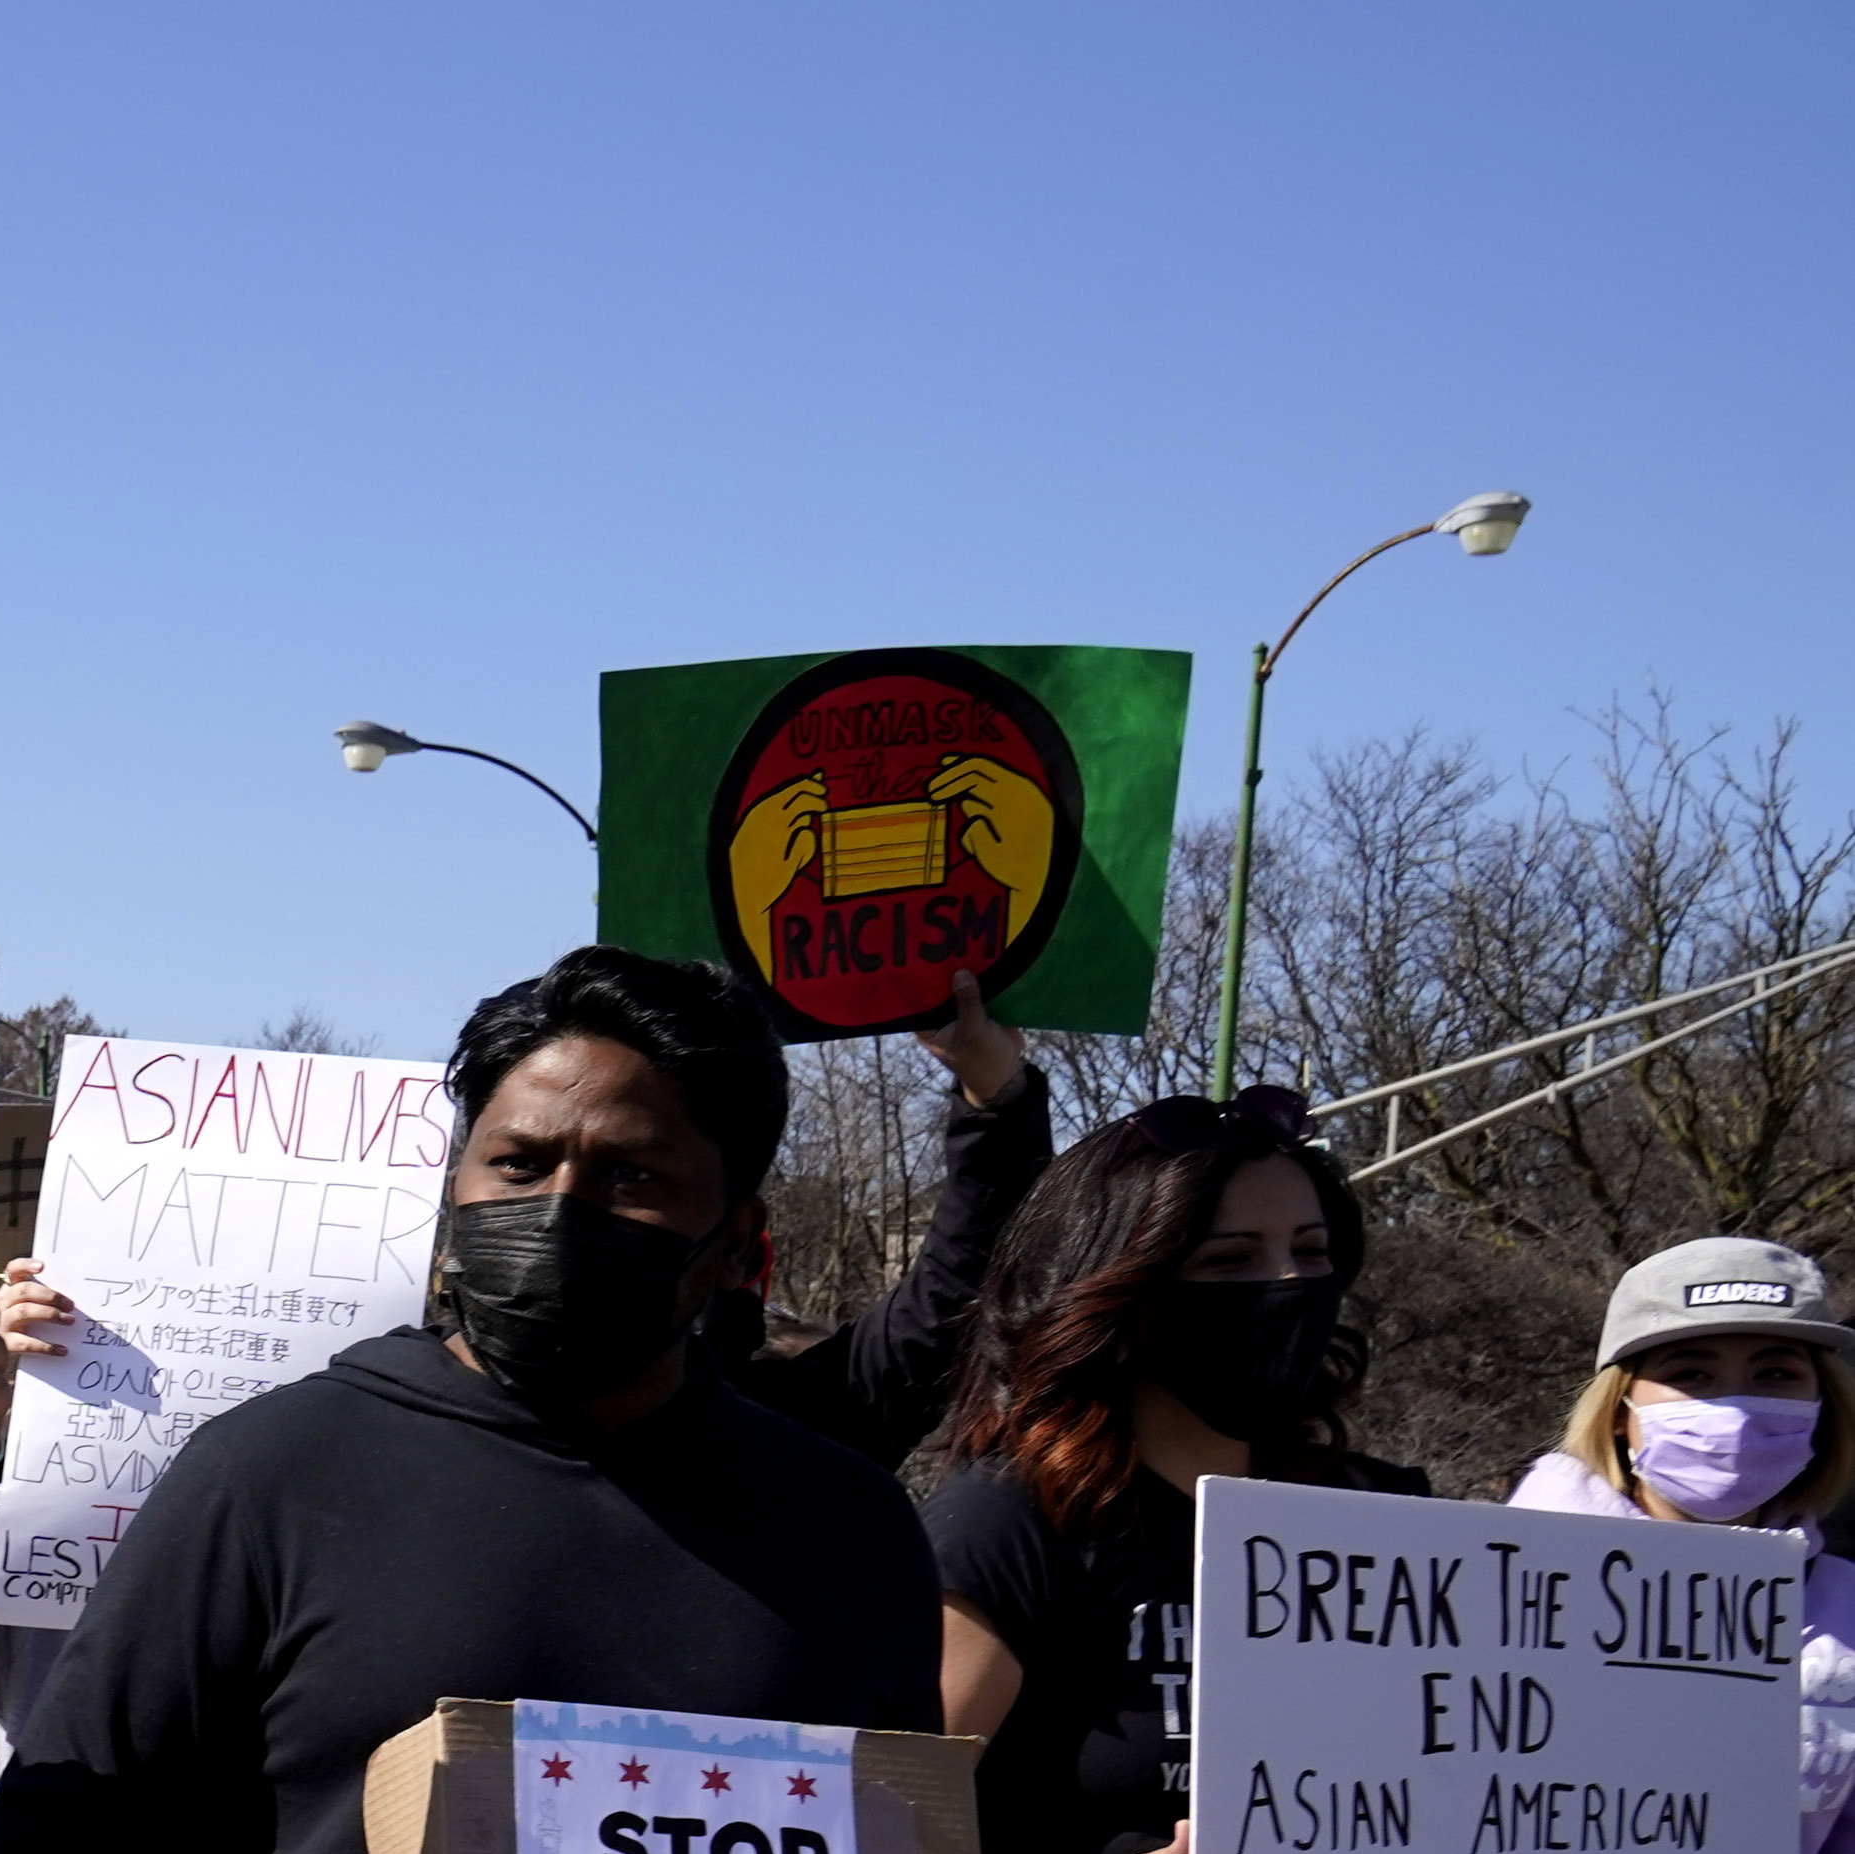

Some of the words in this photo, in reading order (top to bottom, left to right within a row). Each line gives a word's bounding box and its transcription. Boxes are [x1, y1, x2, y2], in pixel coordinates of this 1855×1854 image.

[792, 701, 1003, 758] UNMASK
[783, 894, 1000, 981] RACISM
[52, 1155, 441, 1285] MATTER
[1688, 1283, 1787, 1306] LEADERS
[3, 1529, 81, 1579] LES
[1244, 1534, 1462, 1649] BREAK
[1486, 1541, 1571, 1651] THE
[1593, 1549, 1795, 1665] SILENCE
[1422, 1671, 1555, 1756] END
